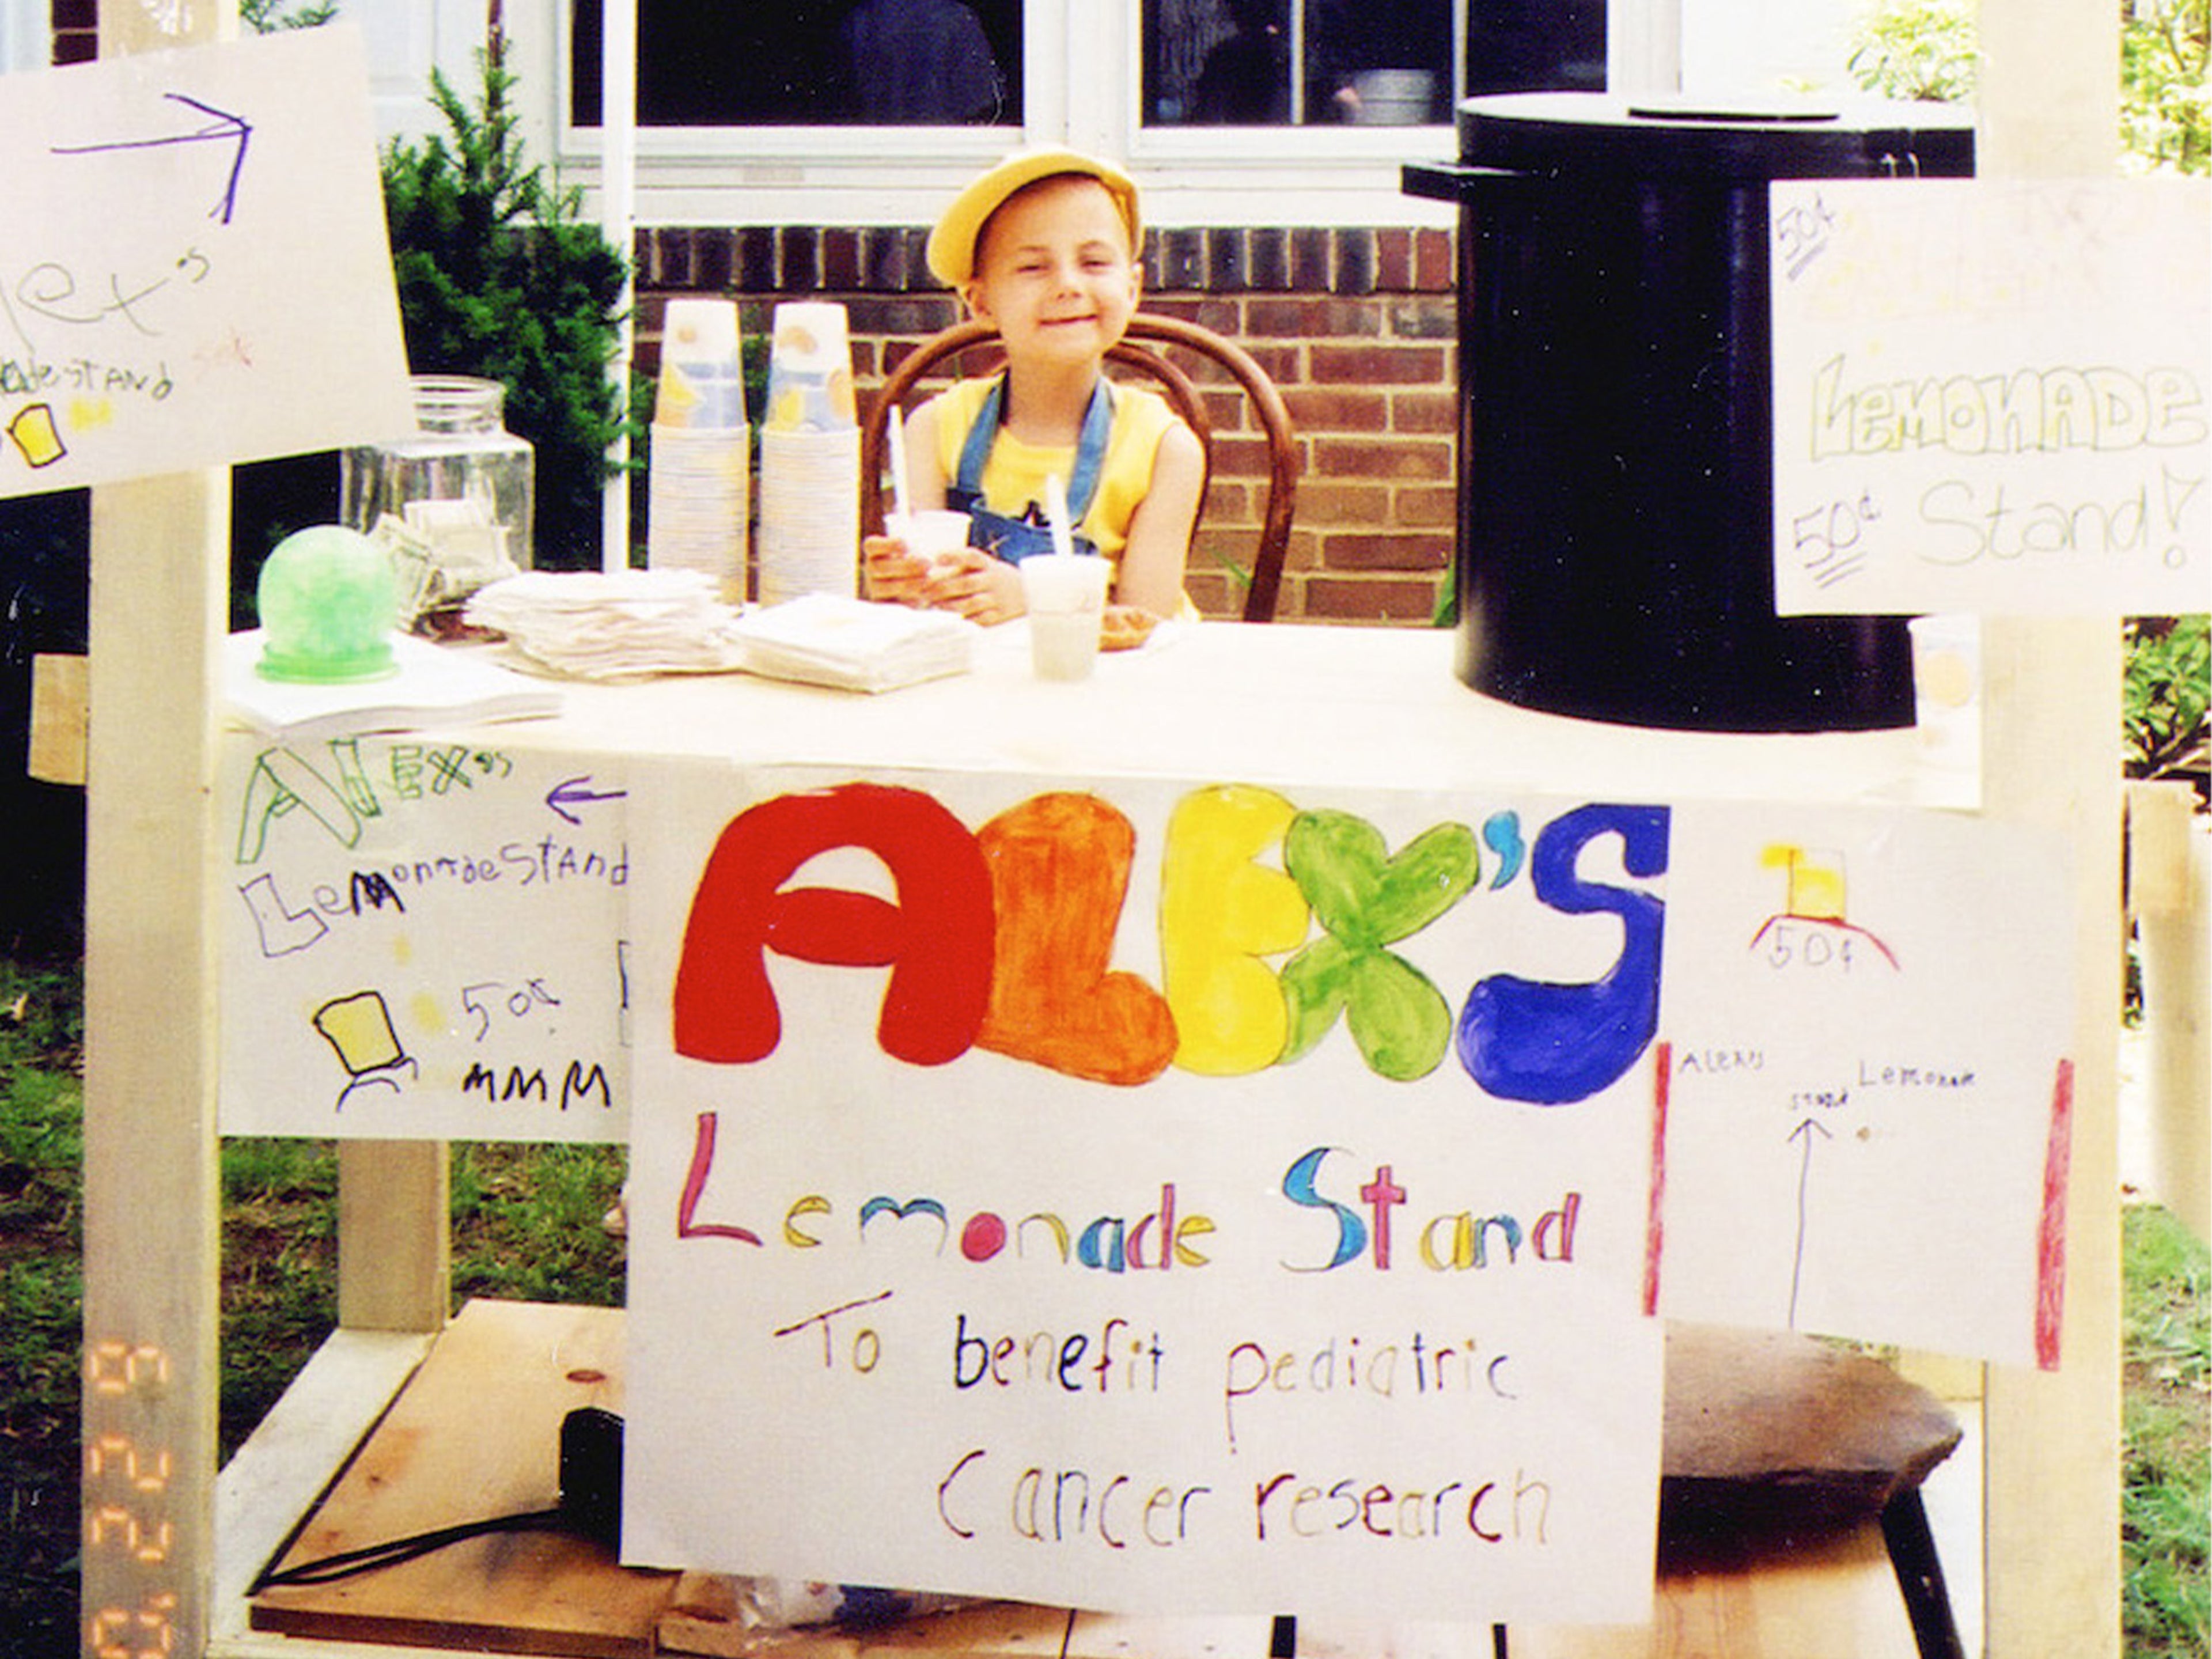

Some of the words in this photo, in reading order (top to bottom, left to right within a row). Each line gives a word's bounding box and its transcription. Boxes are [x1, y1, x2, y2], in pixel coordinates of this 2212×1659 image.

[672, 781, 1671, 1106] ALEX'S
[678, 1111, 1217, 1274] Lemonade
[1279, 1146, 1582, 1272] Stand
[774, 1290, 893, 1374] To
[954, 1314, 1164, 1392] benefit
[1225, 1332, 1518, 1455] pediatric
[1255, 1467, 1551, 1546] research
